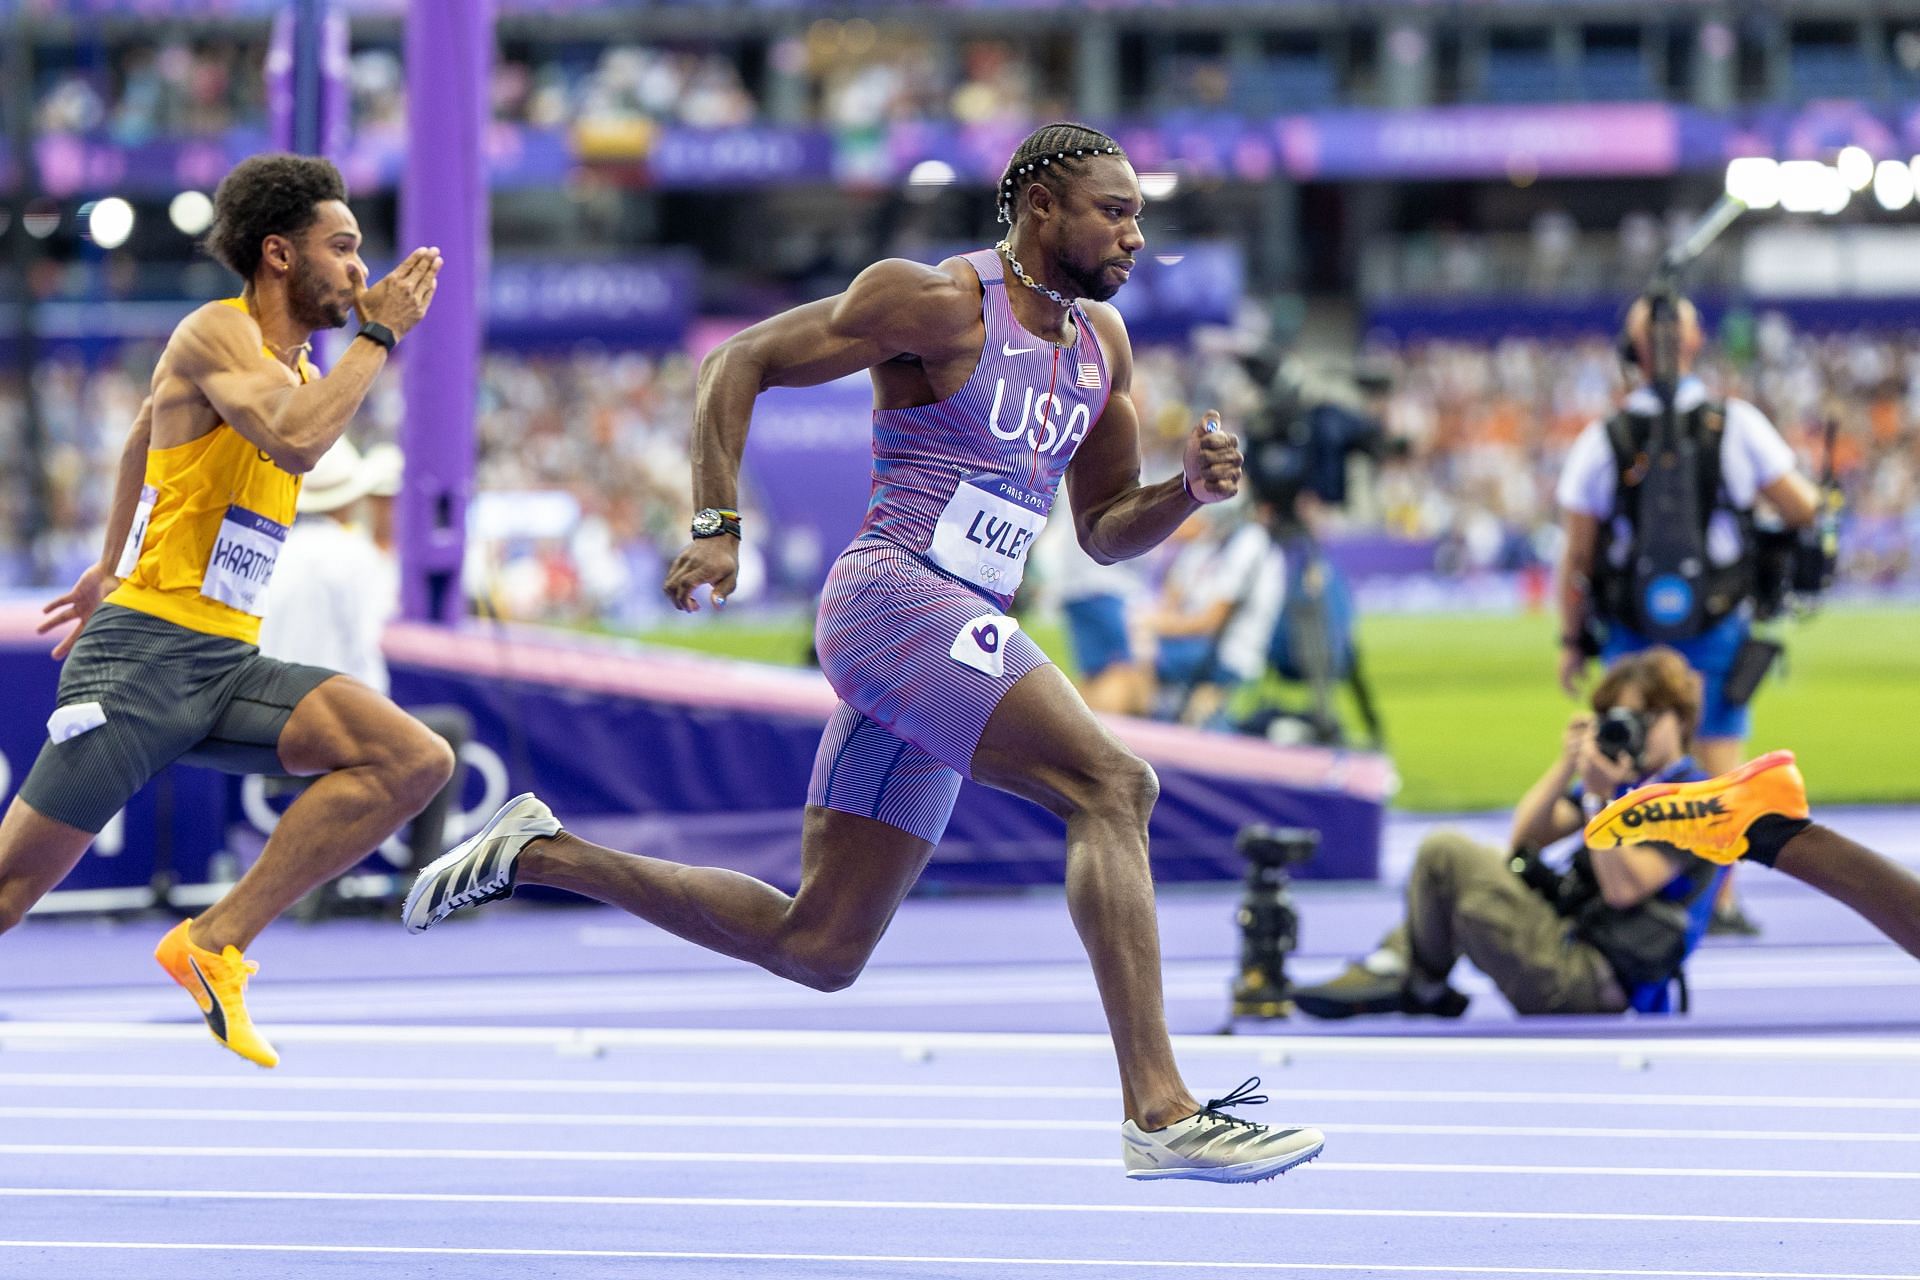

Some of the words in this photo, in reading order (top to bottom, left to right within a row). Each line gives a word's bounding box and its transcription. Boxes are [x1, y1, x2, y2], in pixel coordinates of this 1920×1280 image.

[989, 378, 1090, 461] USA
[1000, 483, 1023, 501] PARIS
[970, 623, 999, 654] 6
[1621, 799, 1728, 827] NITRO
